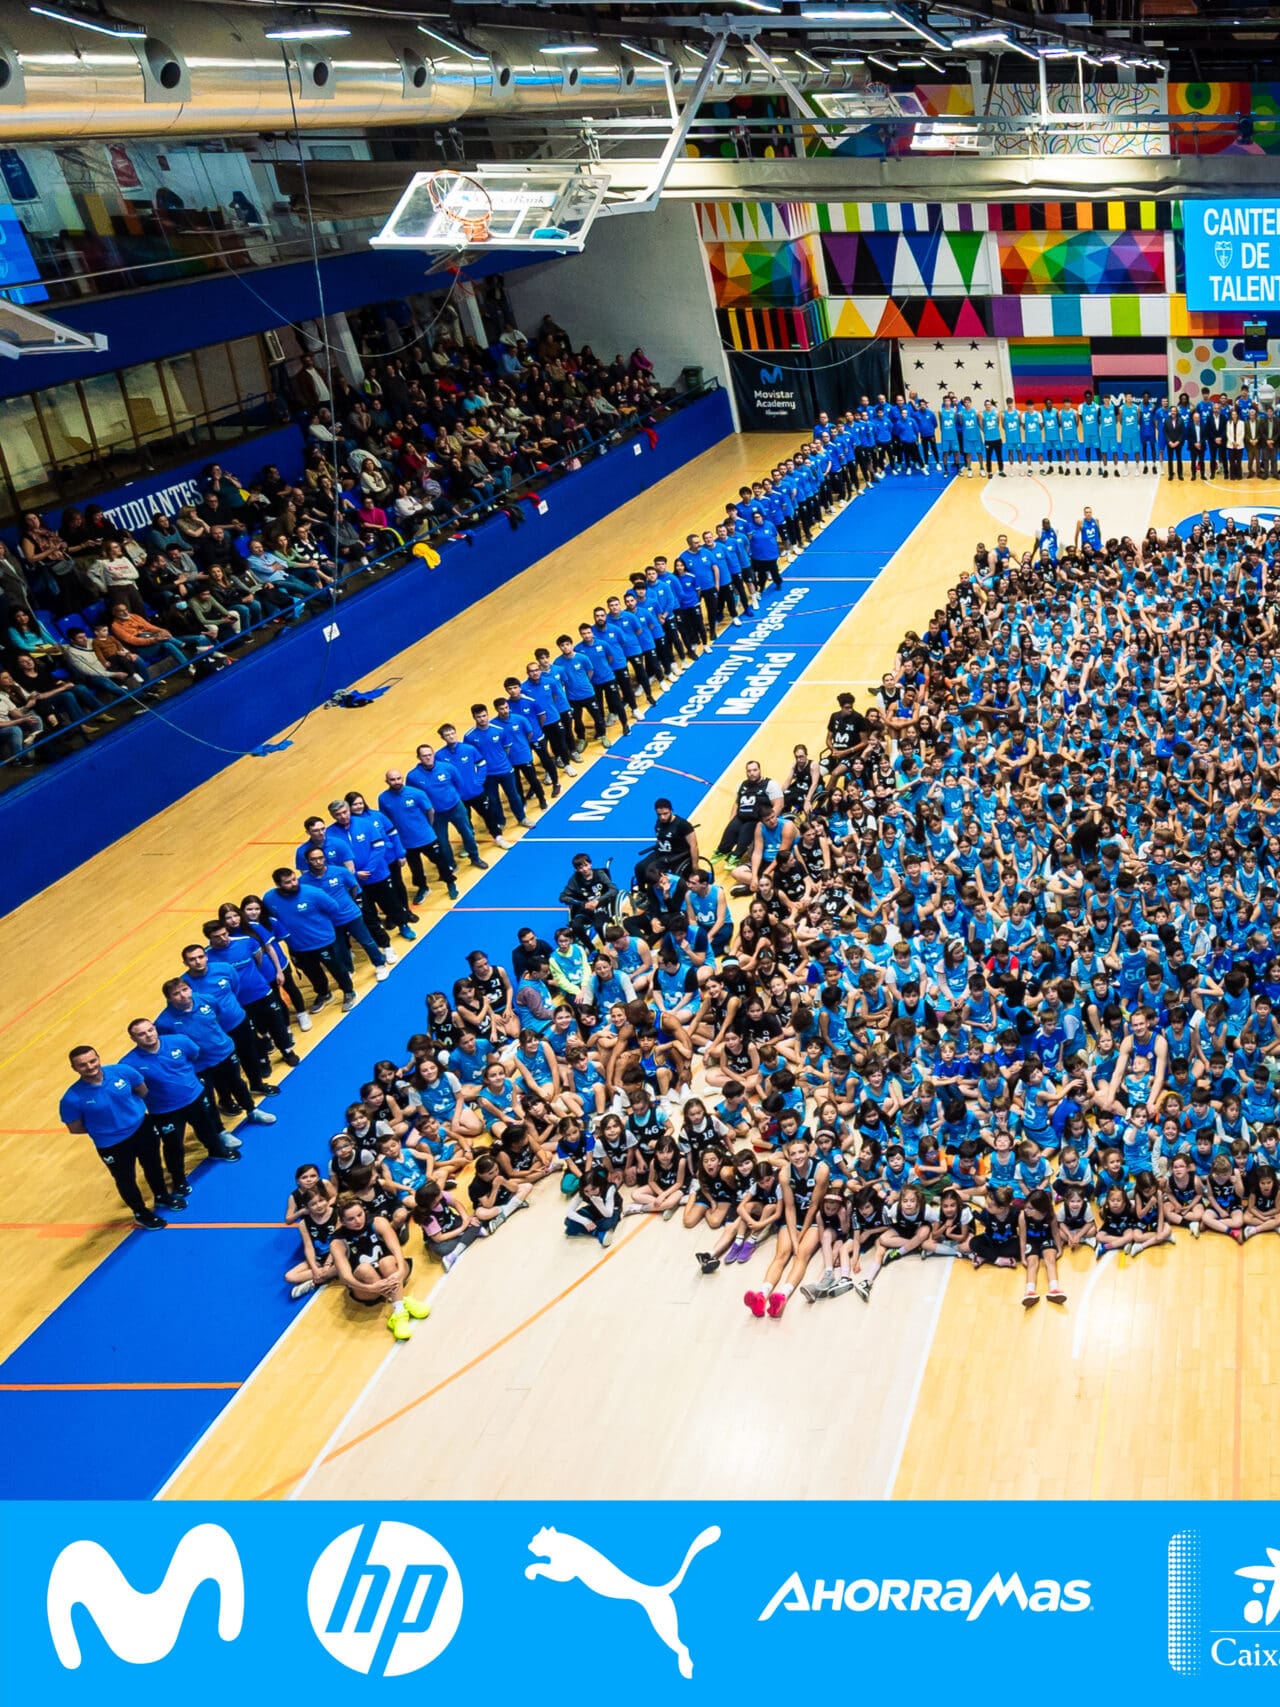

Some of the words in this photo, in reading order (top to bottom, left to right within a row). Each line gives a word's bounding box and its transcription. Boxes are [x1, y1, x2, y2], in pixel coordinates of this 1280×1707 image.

[1241, 243, 1270, 269] DE
[754, 390, 794, 399] Movistar
[756, 399, 796, 409] Academy
[103, 479, 204, 532] TUDIANTES
[715, 652, 797, 715] Madrid
[568, 731, 678, 821] Movistar
[661, 654, 754, 727] Academy
[736, 587, 810, 651] Magariños
[1124, 968, 1145, 981] 60
[490, 979, 501, 987] 21
[440, 1024, 452, 1032] 47
[644, 1125, 659, 1135] 46
[1223, 1187, 1235, 1195] 27
[373, 1194, 386, 1207] 32
